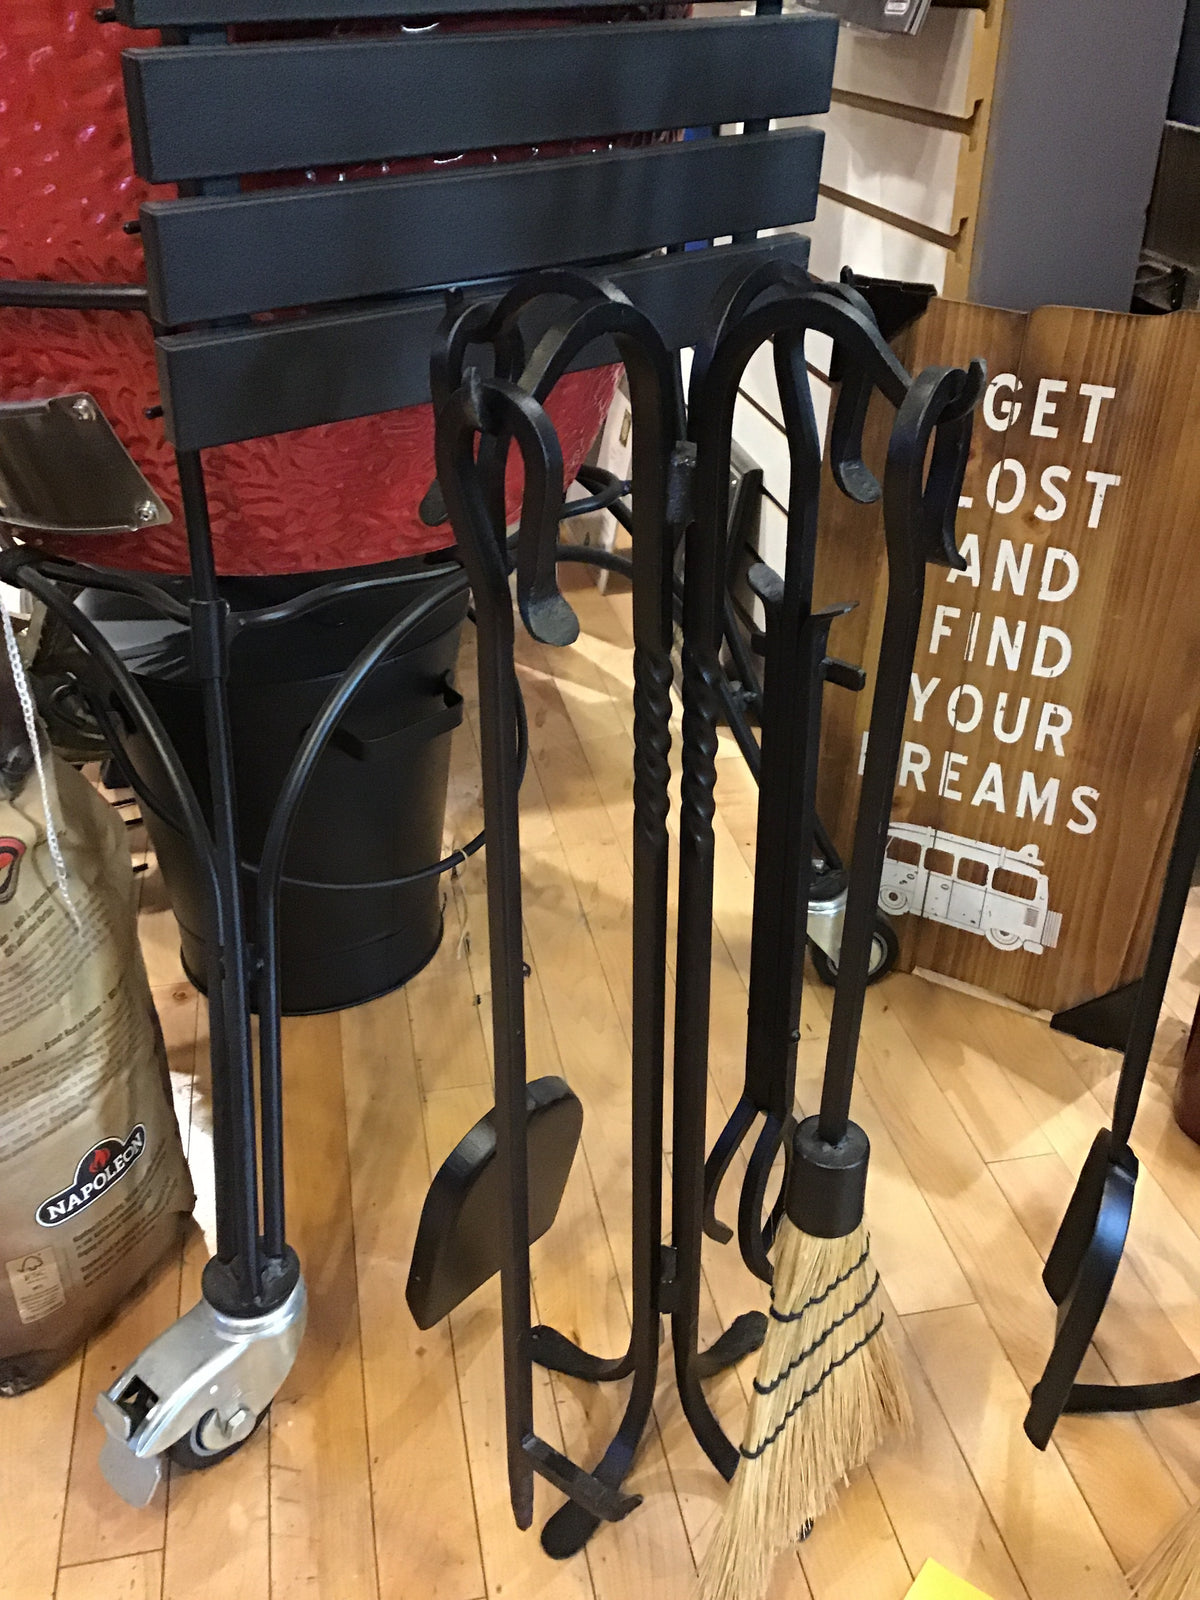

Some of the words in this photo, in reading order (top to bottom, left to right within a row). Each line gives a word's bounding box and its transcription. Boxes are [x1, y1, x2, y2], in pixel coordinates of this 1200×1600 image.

[983, 373, 1116, 443] GET
[958, 458, 1121, 529] OST
[946, 533, 1079, 602] AND
[929, 604, 1072, 678] FIND
[910, 673, 1073, 757] YOUR
[46, 1132, 144, 1221] NAPOLEON
